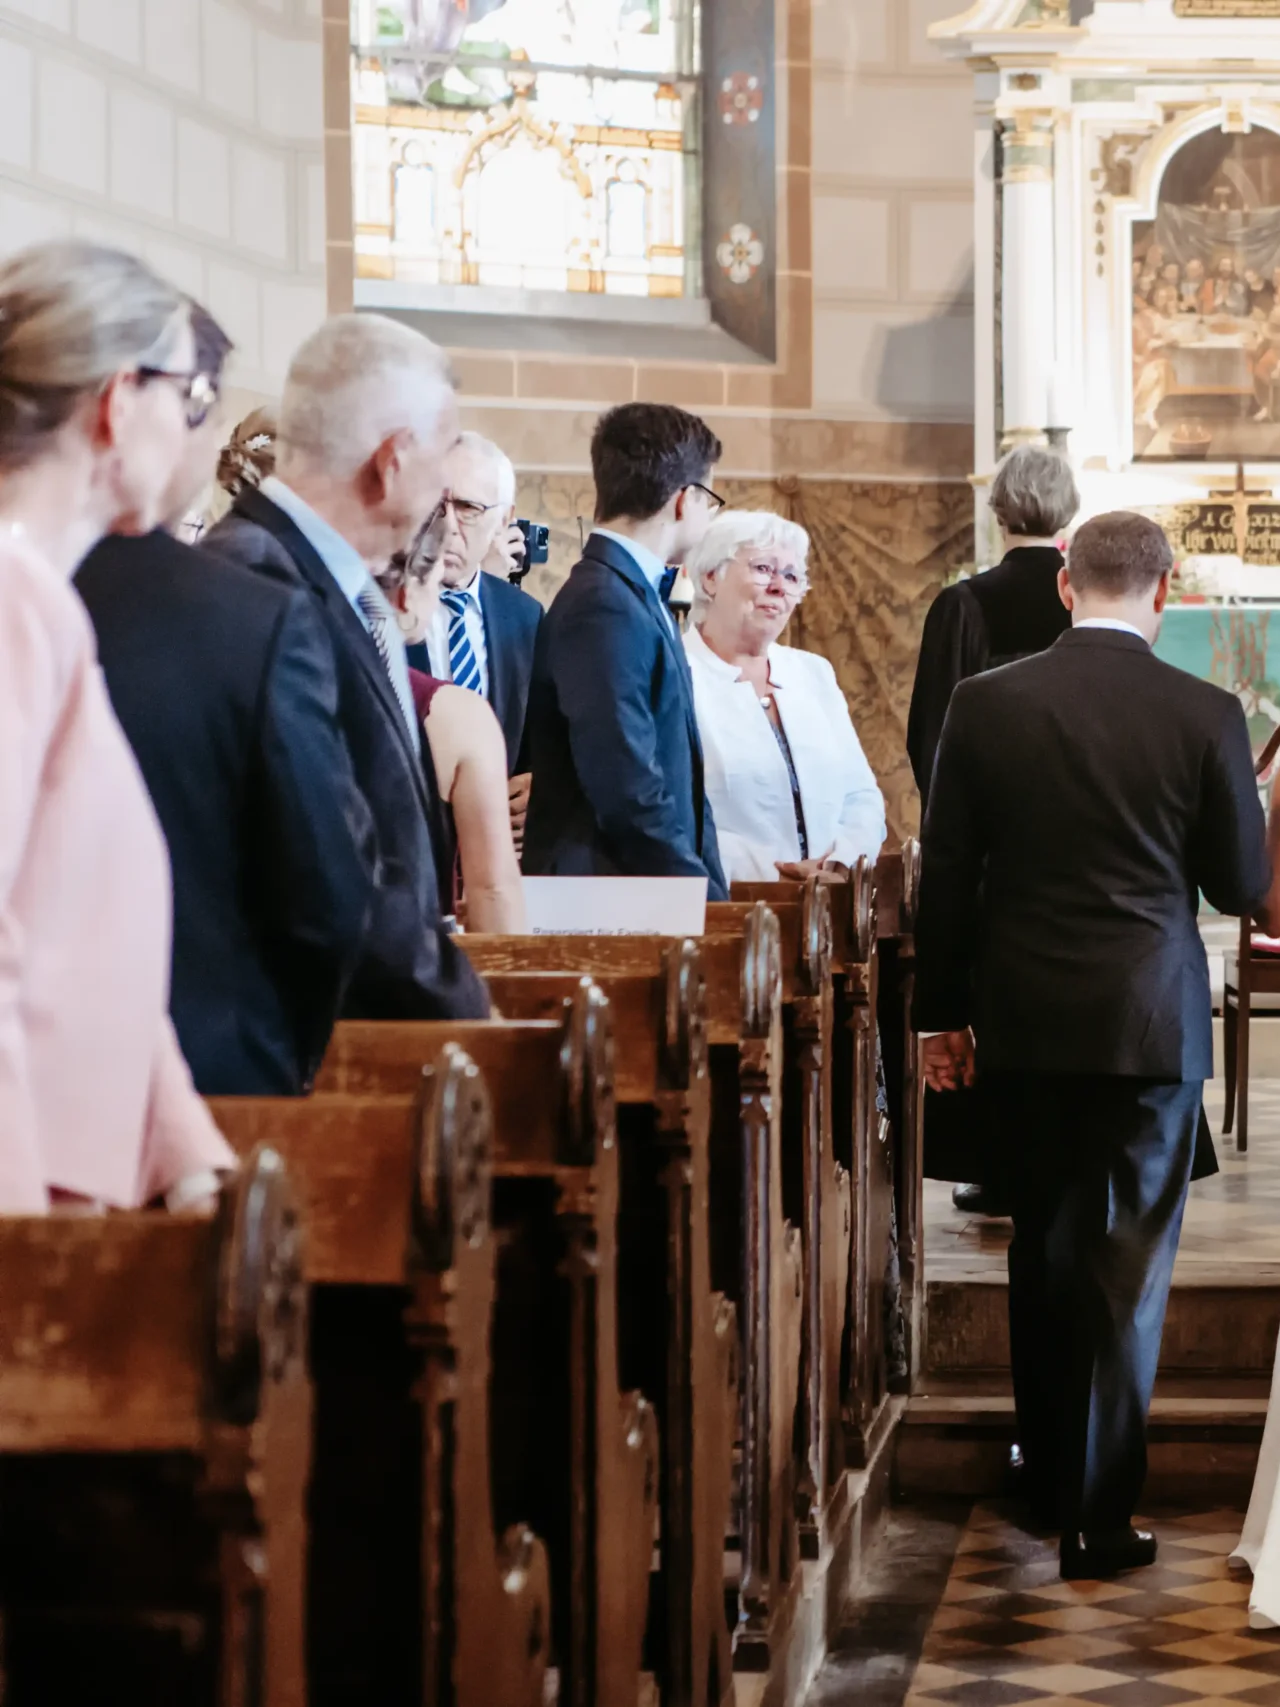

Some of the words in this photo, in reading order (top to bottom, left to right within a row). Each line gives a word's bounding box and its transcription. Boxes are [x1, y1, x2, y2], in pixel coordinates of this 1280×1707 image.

[532, 927, 593, 936] Reserviert
[597, 927, 614, 936] für
[618, 927, 660, 936] Familie
